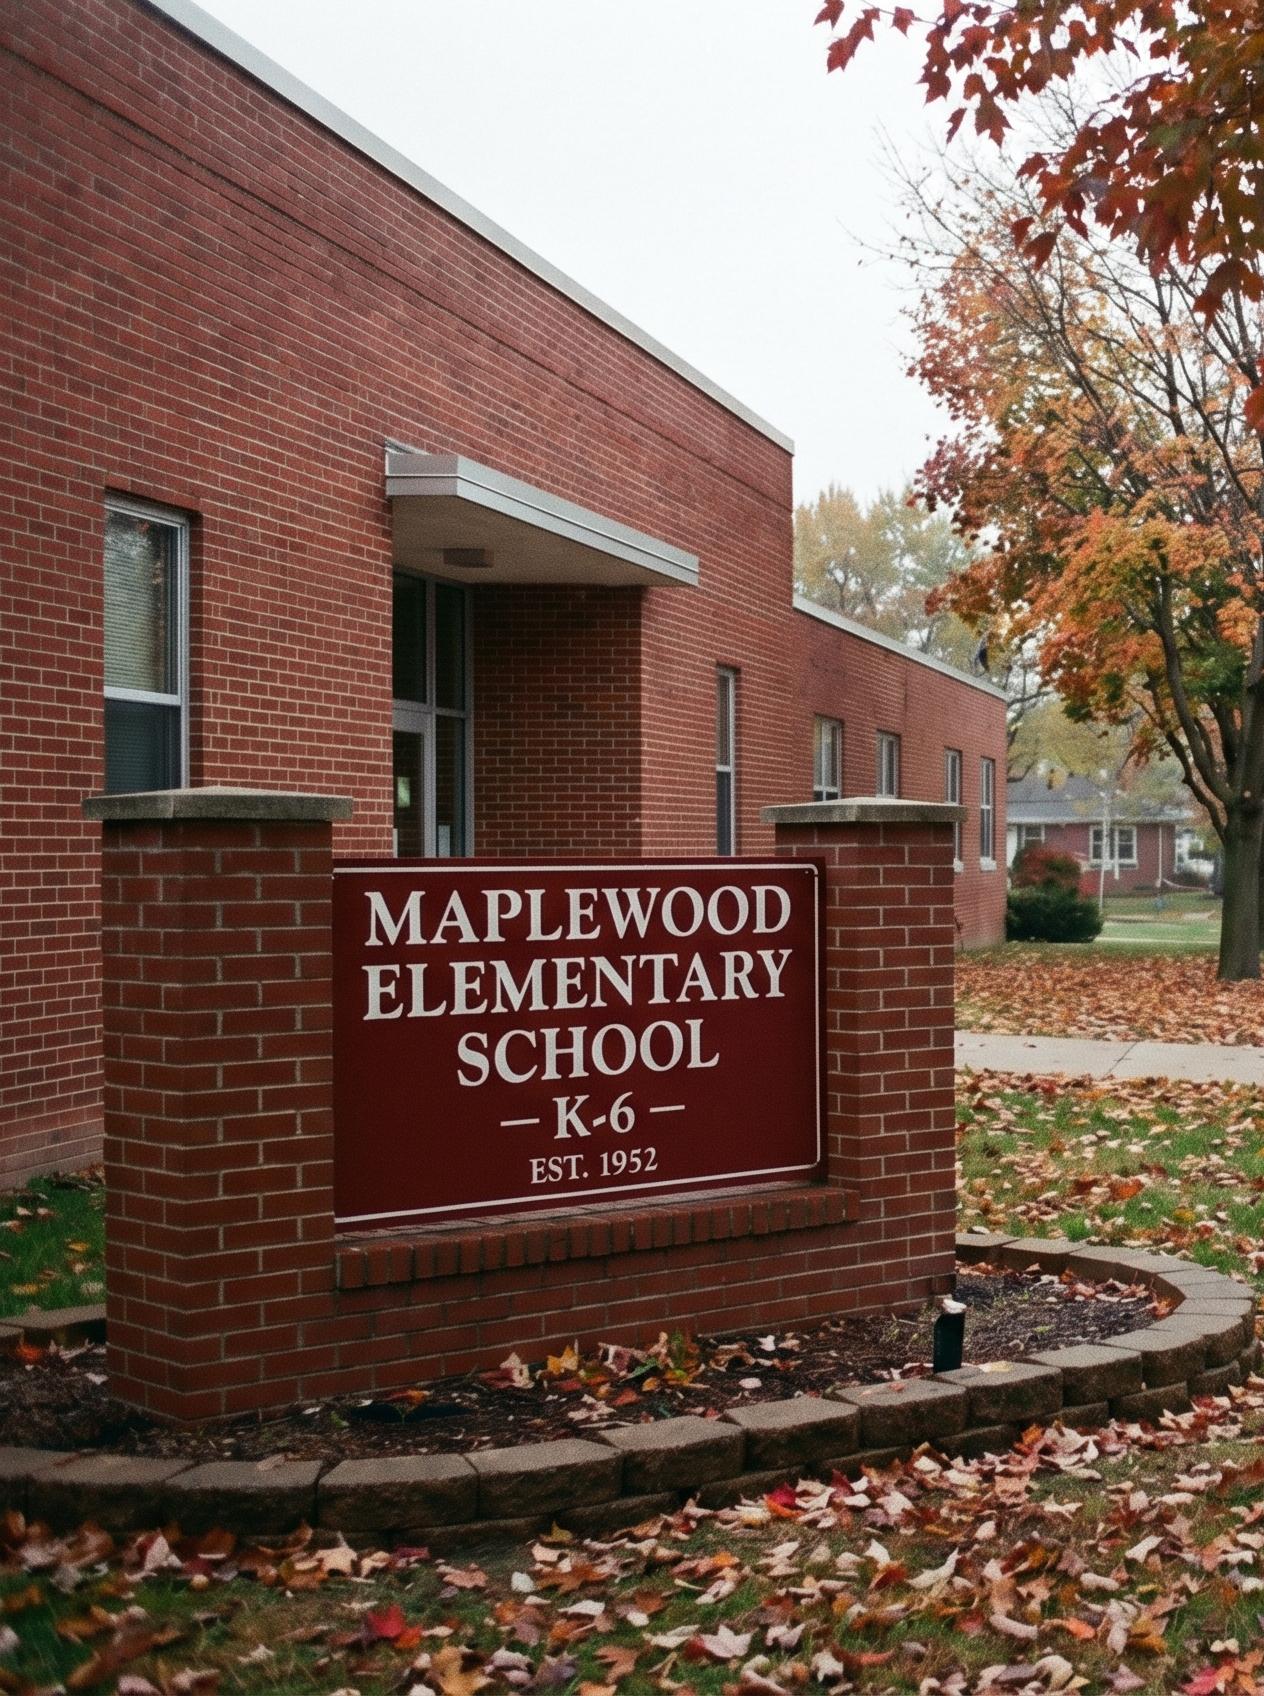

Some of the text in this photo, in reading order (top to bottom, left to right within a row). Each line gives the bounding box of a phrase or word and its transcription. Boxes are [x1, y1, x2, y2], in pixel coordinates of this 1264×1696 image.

[364, 885, 792, 947] MAPLEWOOD
[361, 948, 793, 1021] ELEMENTARY
[456, 1018, 720, 1087] SCHOOL
[552, 1091, 636, 1140] K-6
[529, 1147, 659, 1185] EST. 1952
